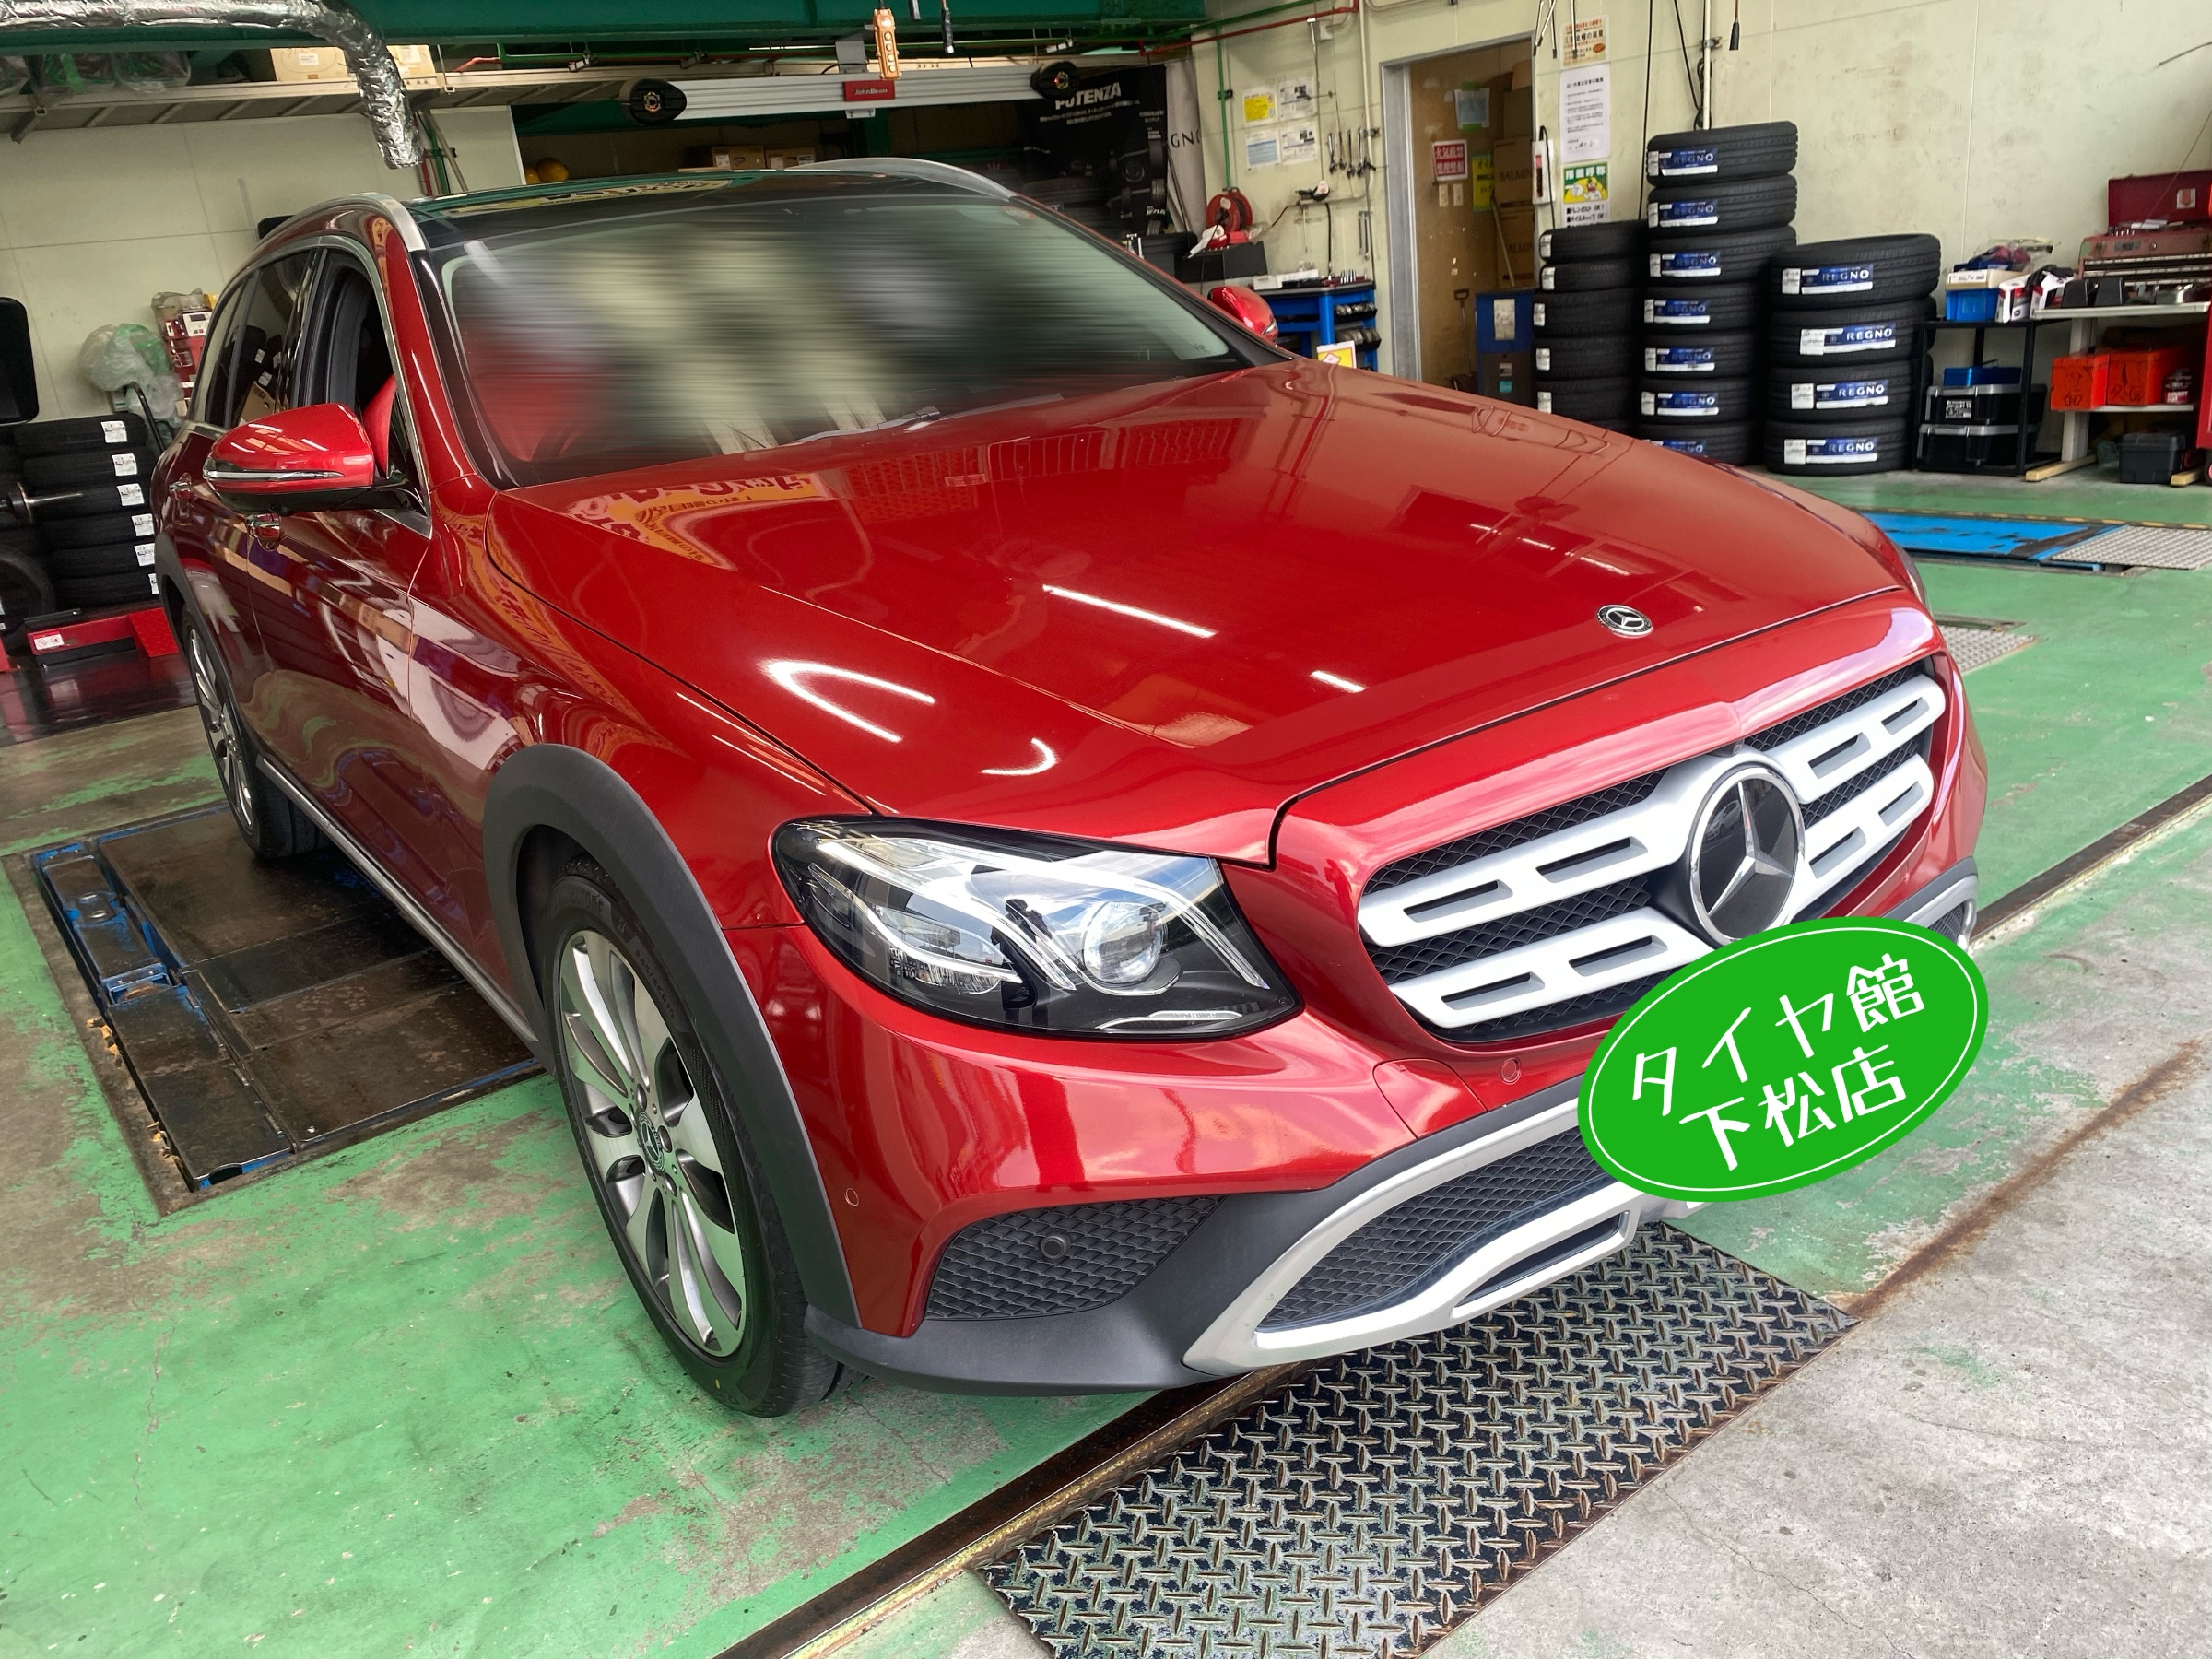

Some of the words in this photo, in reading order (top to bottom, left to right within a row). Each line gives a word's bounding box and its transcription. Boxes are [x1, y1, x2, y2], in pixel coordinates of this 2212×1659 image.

[1674, 153, 1713, 164] REGNO
[1675, 205, 1713, 216] REGNO
[1677, 256, 1716, 267] REGNO
[1822, 269, 1869, 281] REGNO
[1667, 305, 1705, 314] REGNO
[1847, 328, 1892, 341] REGNO
[1671, 352, 1711, 361] REGNO
[1839, 384, 1884, 397] REGNO
[1675, 395, 1715, 406] REGNO
[1829, 441, 1874, 453] REGNO
